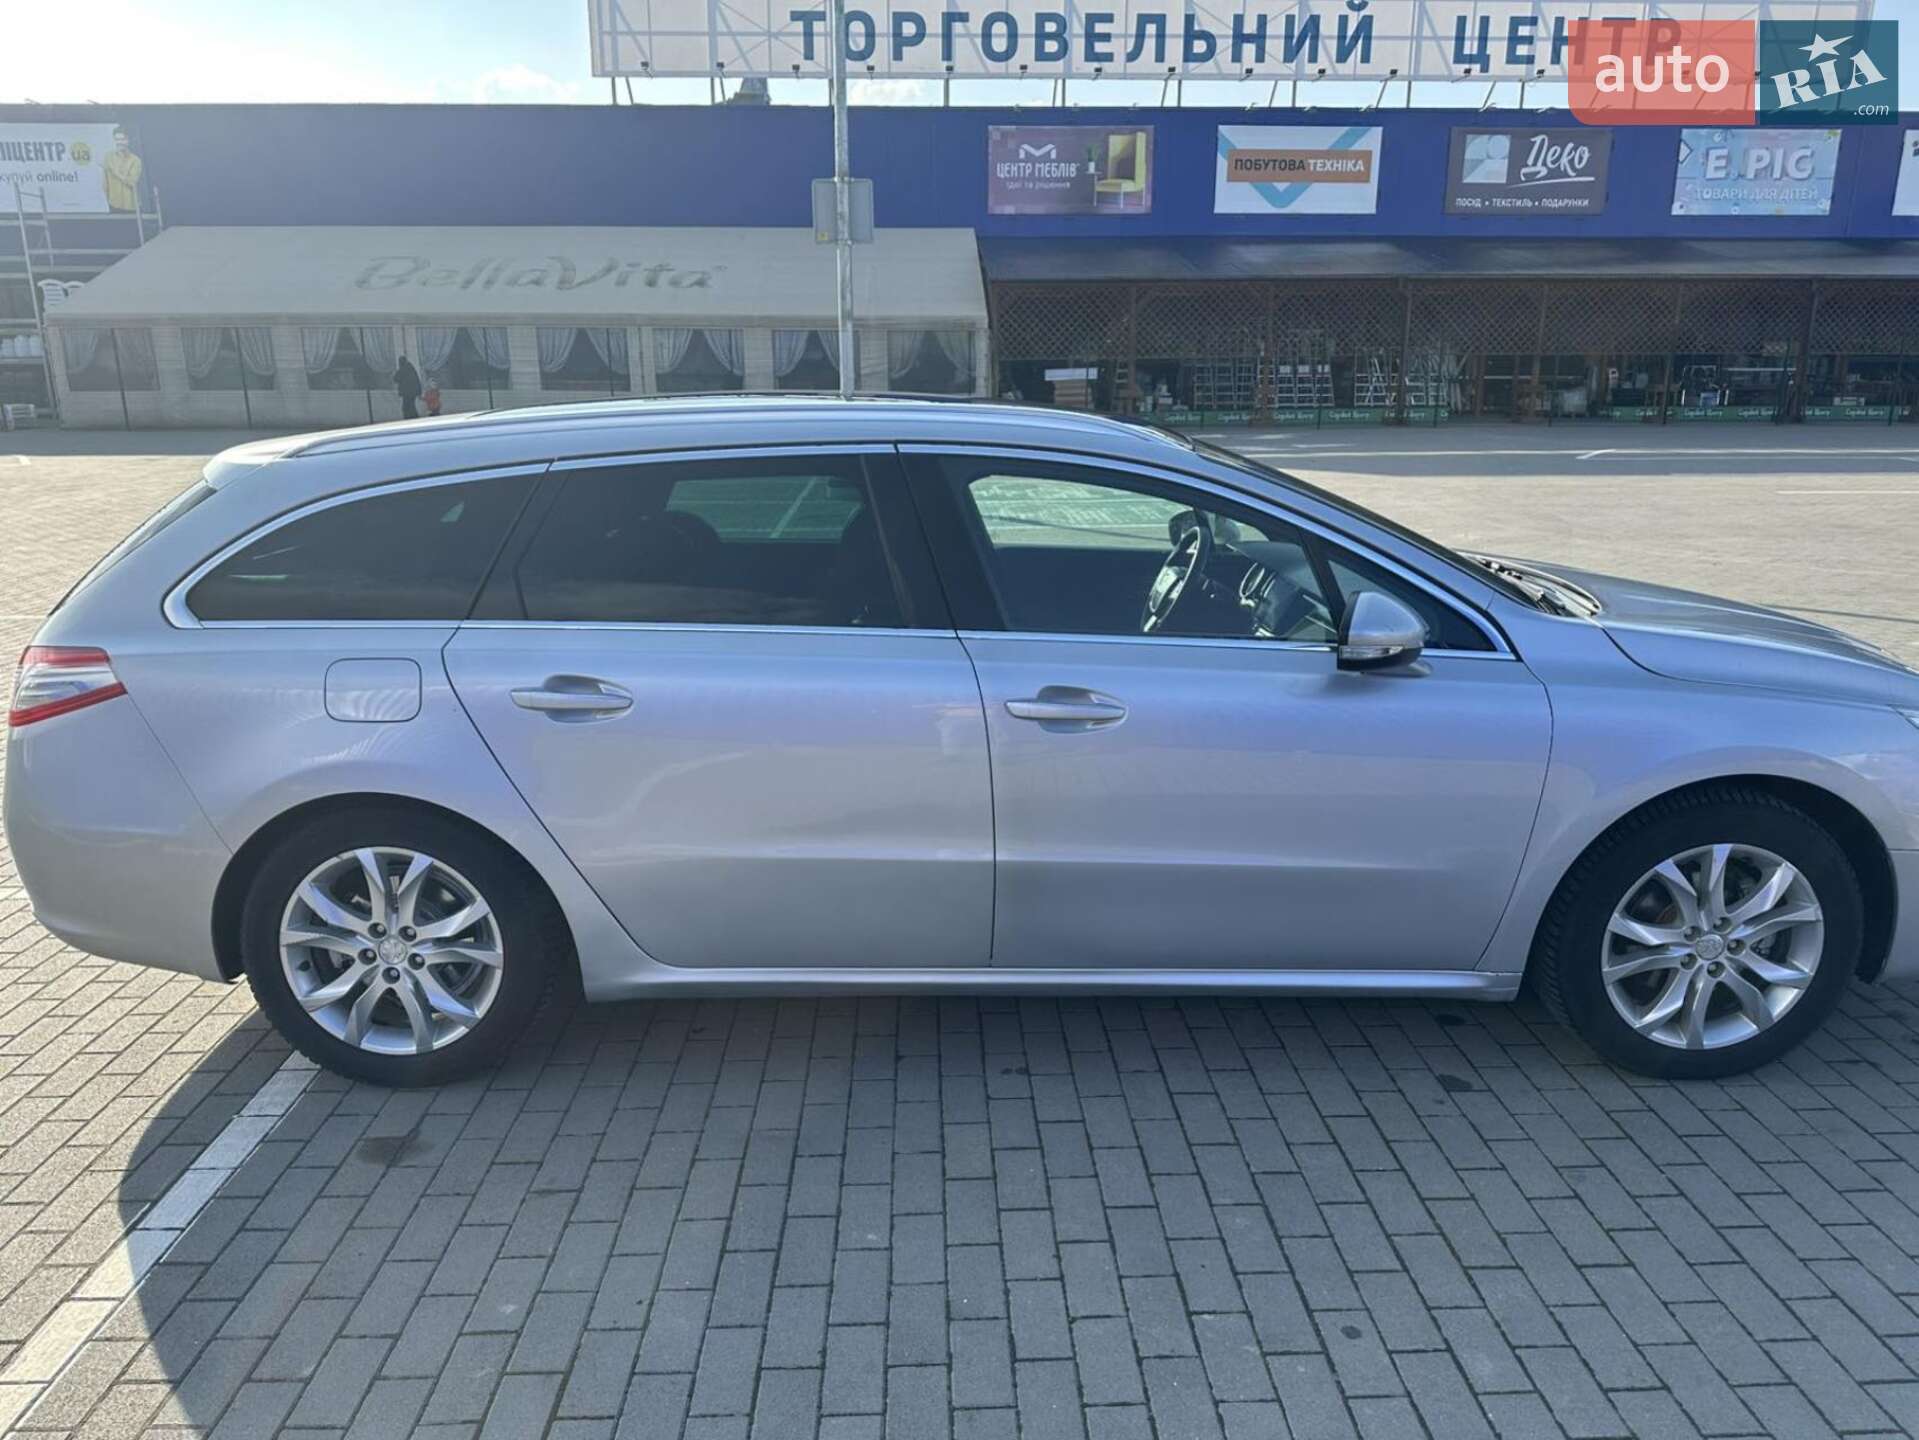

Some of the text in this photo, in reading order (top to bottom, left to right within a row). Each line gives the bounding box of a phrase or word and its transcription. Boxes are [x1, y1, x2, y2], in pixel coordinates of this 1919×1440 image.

[789, 0, 1682, 73] ТОРГОВЕЛЬНИЙ ЦЕНТР
[1234, 158, 1365, 172] ПОБУТОВА ТЕХНІКА
[1520, 134, 1590, 181] Деко
[996, 163, 1077, 179] ЦЕНТР МЕБЛІВ
[1695, 187, 1747, 200] ТОВАРИ
[1749, 188, 1777, 200] ДЛЯ
[1456, 198, 1590, 209] ПОСУД ТЕКСТИЛЬ ПОДАРУНКИ
